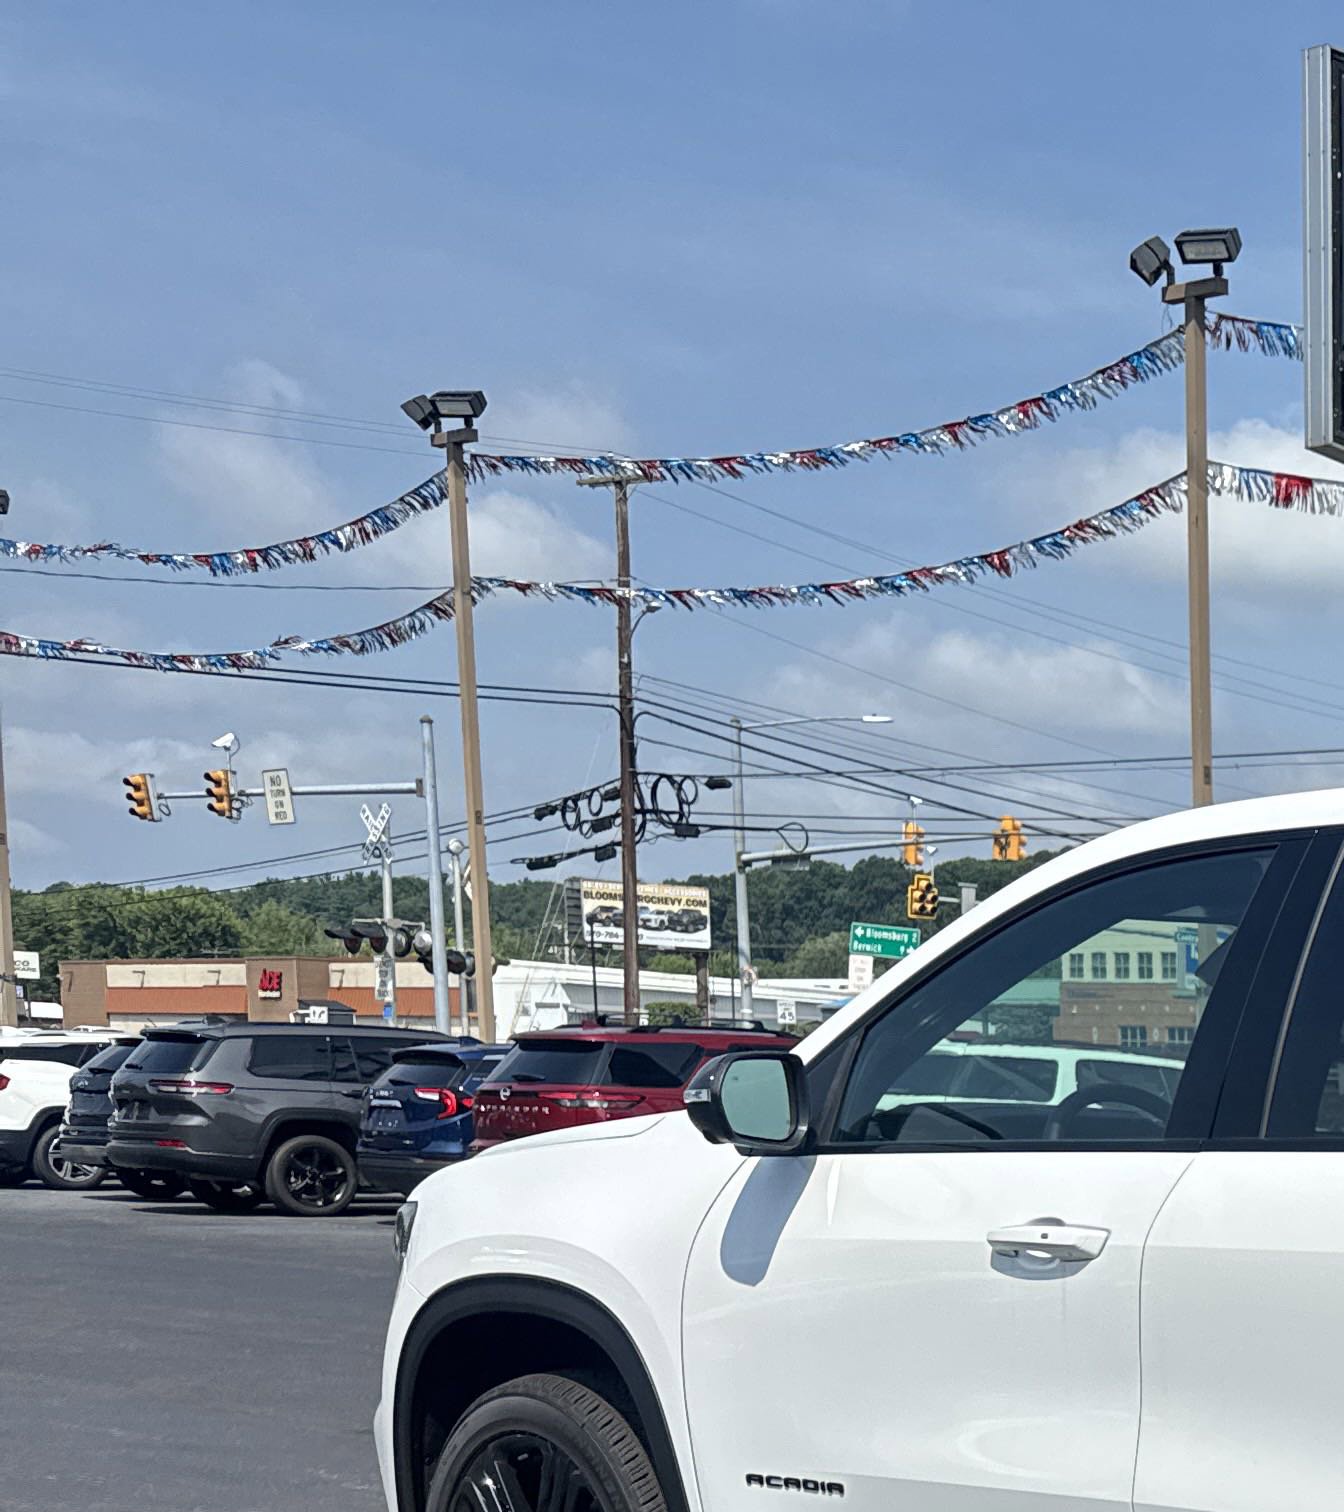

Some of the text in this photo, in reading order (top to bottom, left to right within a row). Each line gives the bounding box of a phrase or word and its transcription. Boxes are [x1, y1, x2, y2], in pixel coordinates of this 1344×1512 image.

[270, 774, 281, 787] NO
[259, 969, 282, 991] ACE
[780, 1012, 795, 1021] 45
[745, 1473, 845, 1498] ACADIA
